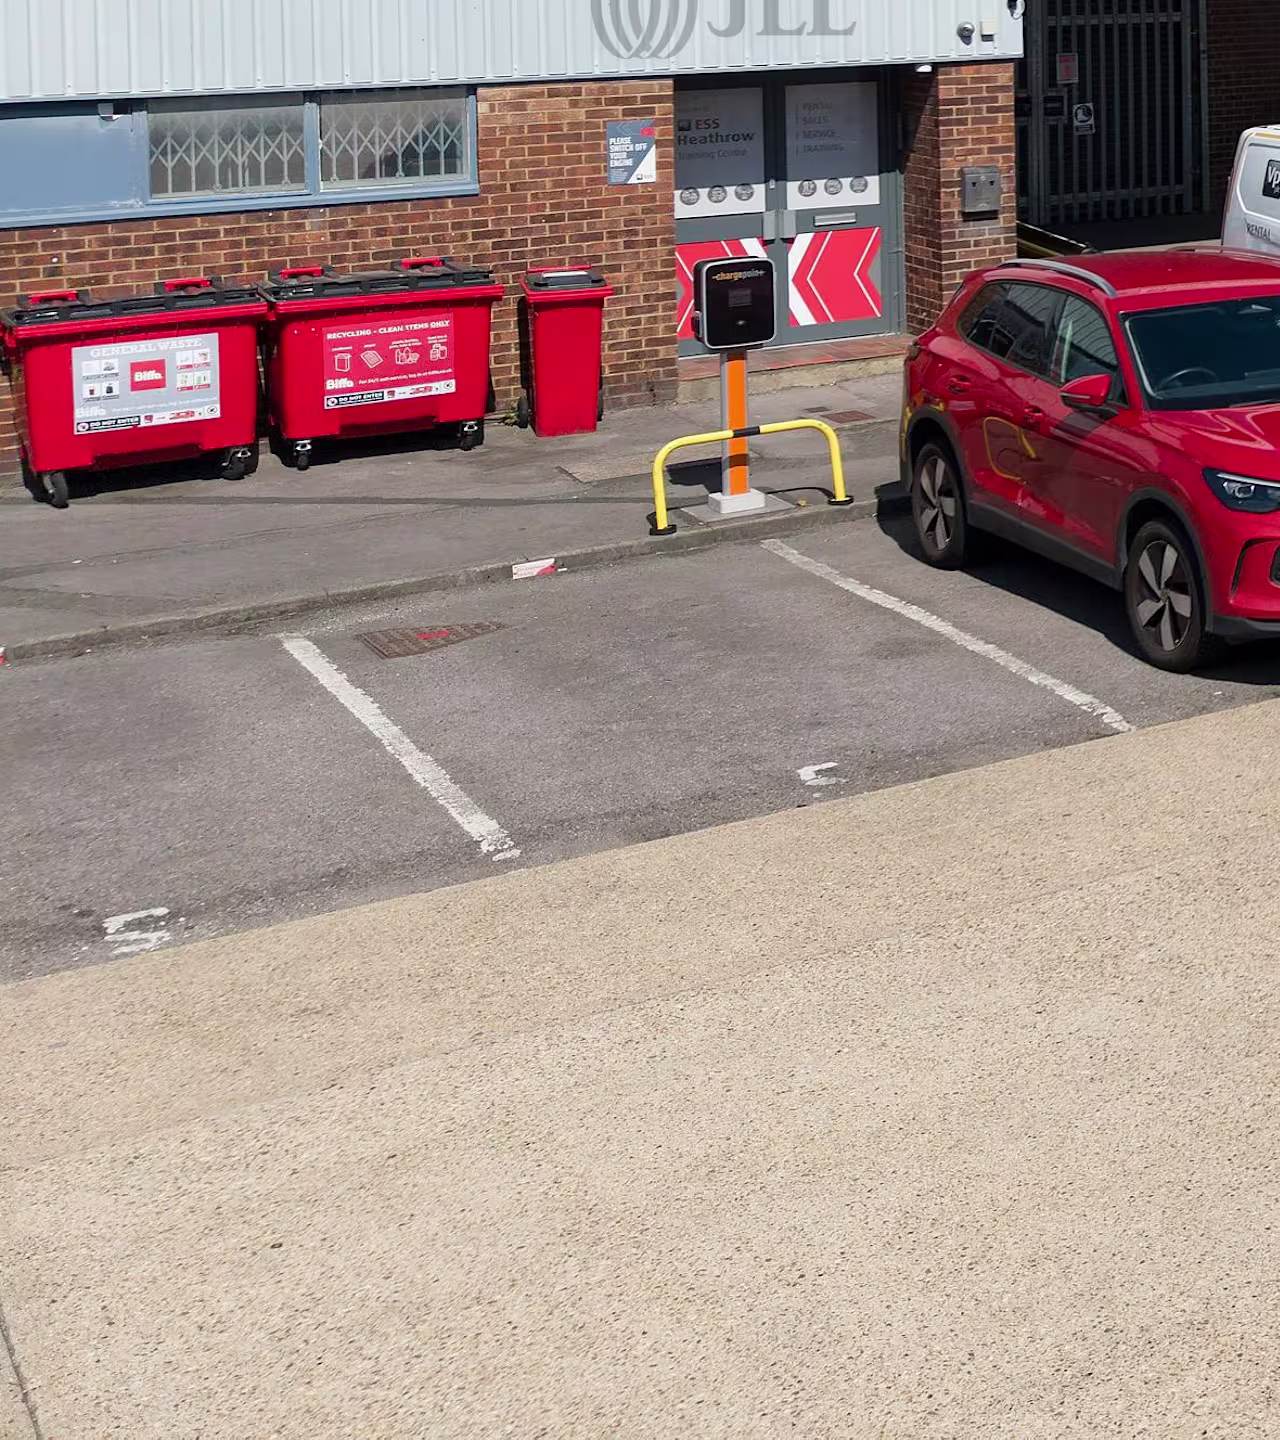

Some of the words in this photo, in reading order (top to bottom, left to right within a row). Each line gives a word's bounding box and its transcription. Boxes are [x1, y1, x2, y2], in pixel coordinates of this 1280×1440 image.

[695, 117, 720, 131] ESS
[677, 130, 756, 146] Heathrow
[1246, 222, 1271, 242] RENTAL
[326, 329, 372, 340] RECYCLING
[378, 326, 404, 335] CLEAN
[404, 323, 429, 331] ITEMS
[429, 320, 450, 328] ONLY
[89, 342, 157, 359] GENERAL
[157, 337, 203, 351] WASTE
[133, 369, 163, 383] Biffa
[325, 378, 355, 390] Biffa
[116, 417, 140, 426] ENTER
